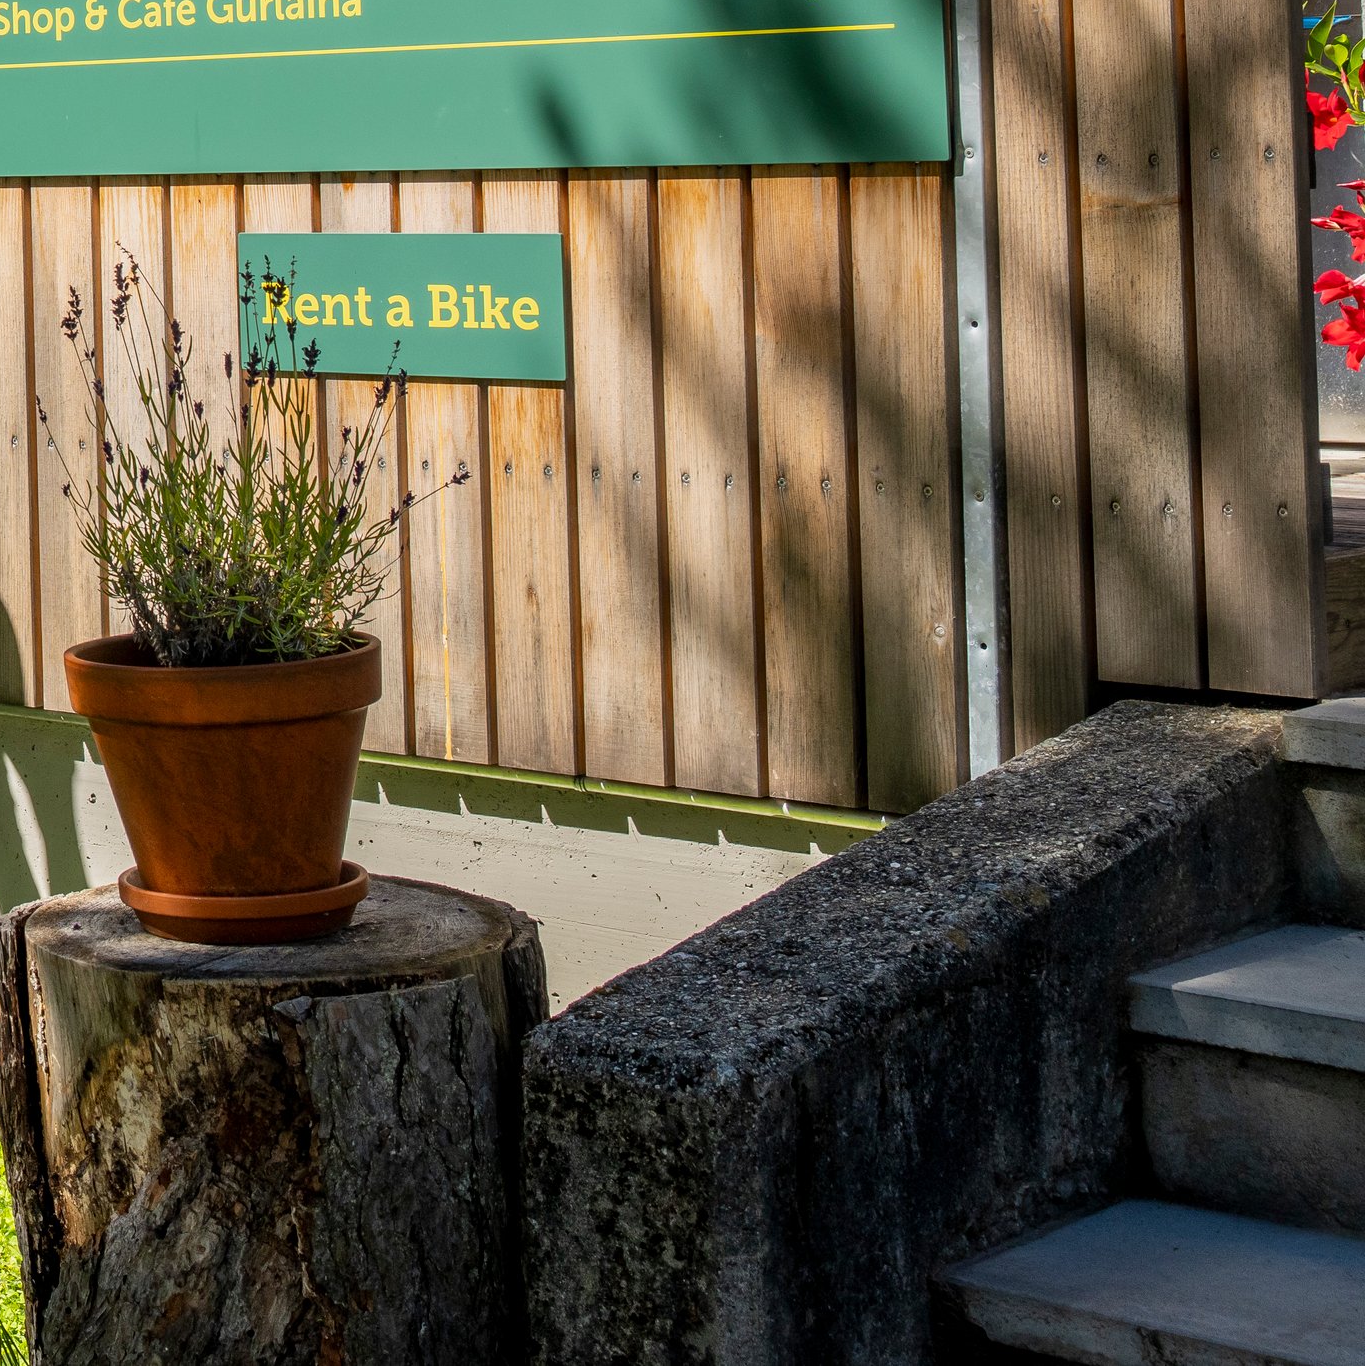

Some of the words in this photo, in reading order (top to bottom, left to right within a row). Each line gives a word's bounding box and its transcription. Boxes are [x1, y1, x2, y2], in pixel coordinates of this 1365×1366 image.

[260, 281, 373, 328] Rent
[385, 294, 414, 328] a
[426, 284, 541, 331] Bike
